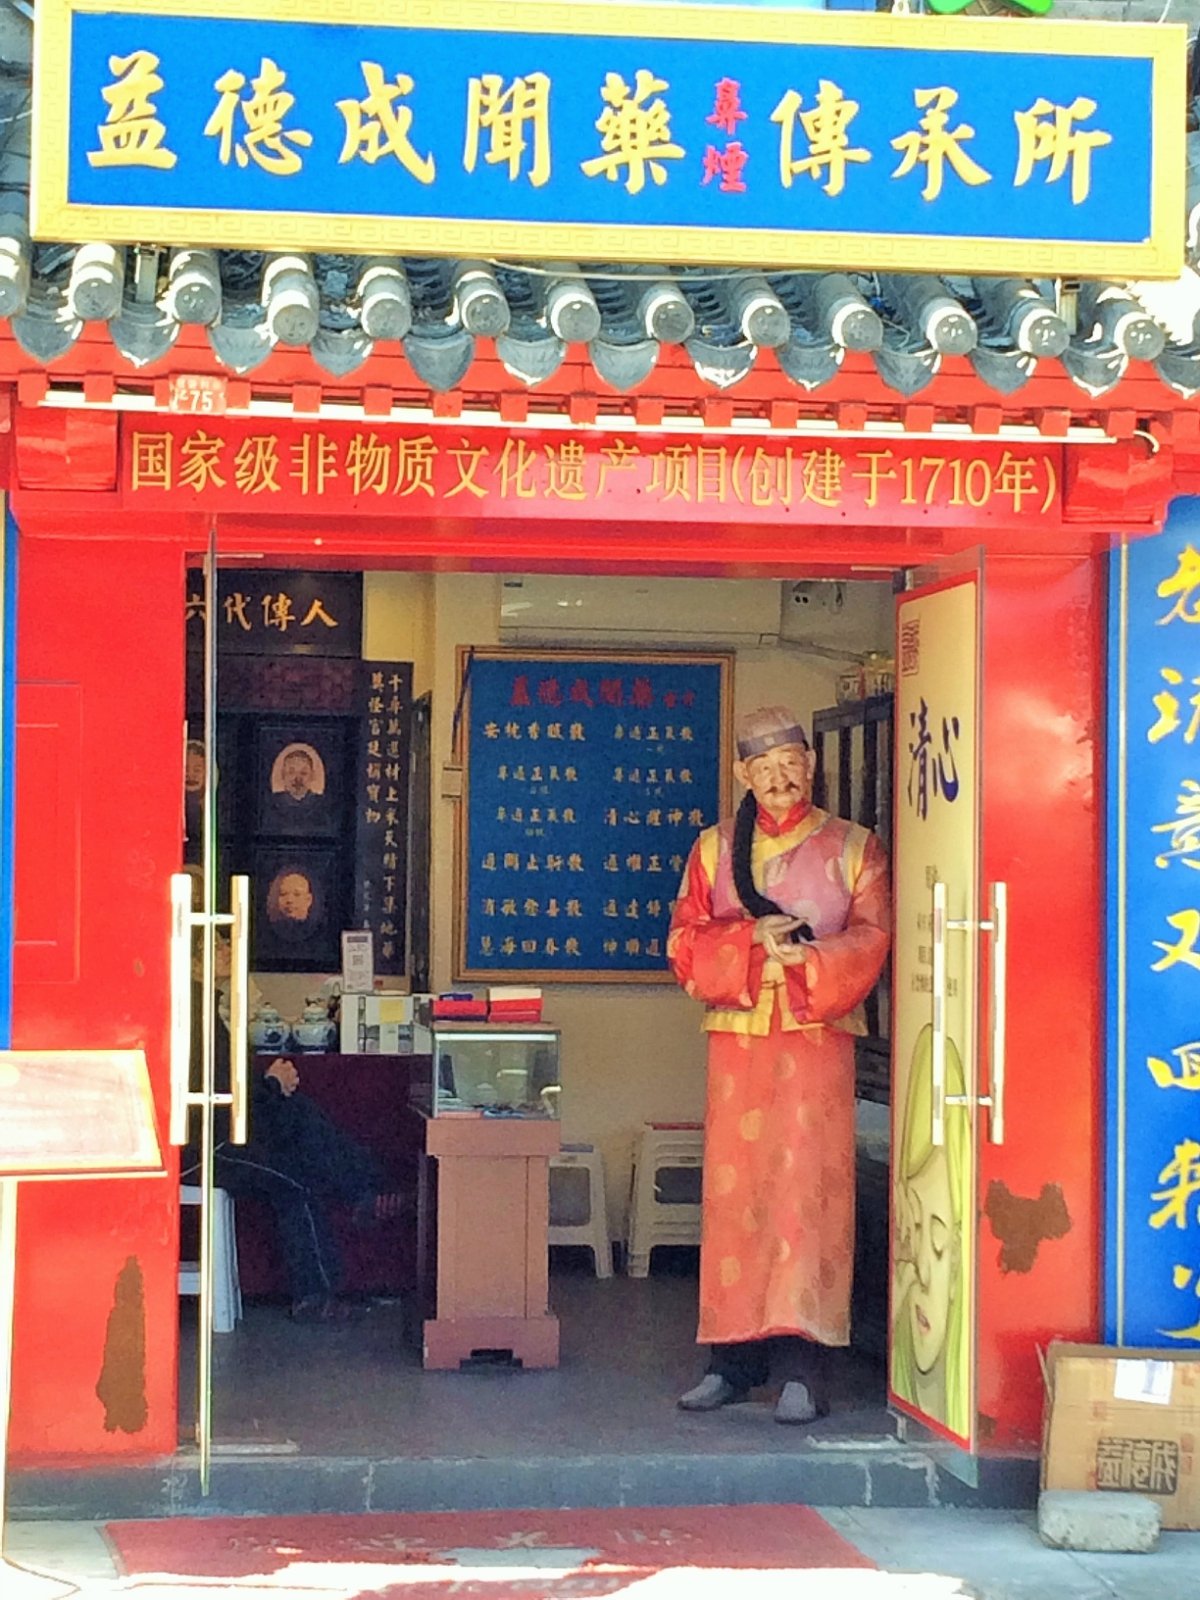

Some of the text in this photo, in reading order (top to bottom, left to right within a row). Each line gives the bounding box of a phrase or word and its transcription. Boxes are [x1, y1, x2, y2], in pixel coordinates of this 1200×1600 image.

[87, 50, 1112, 206] 益德成聞藥 鼻煙 傳承所
[131, 430, 1057, 514] 国家级非物质文化遗产项目(创建于1710年)
